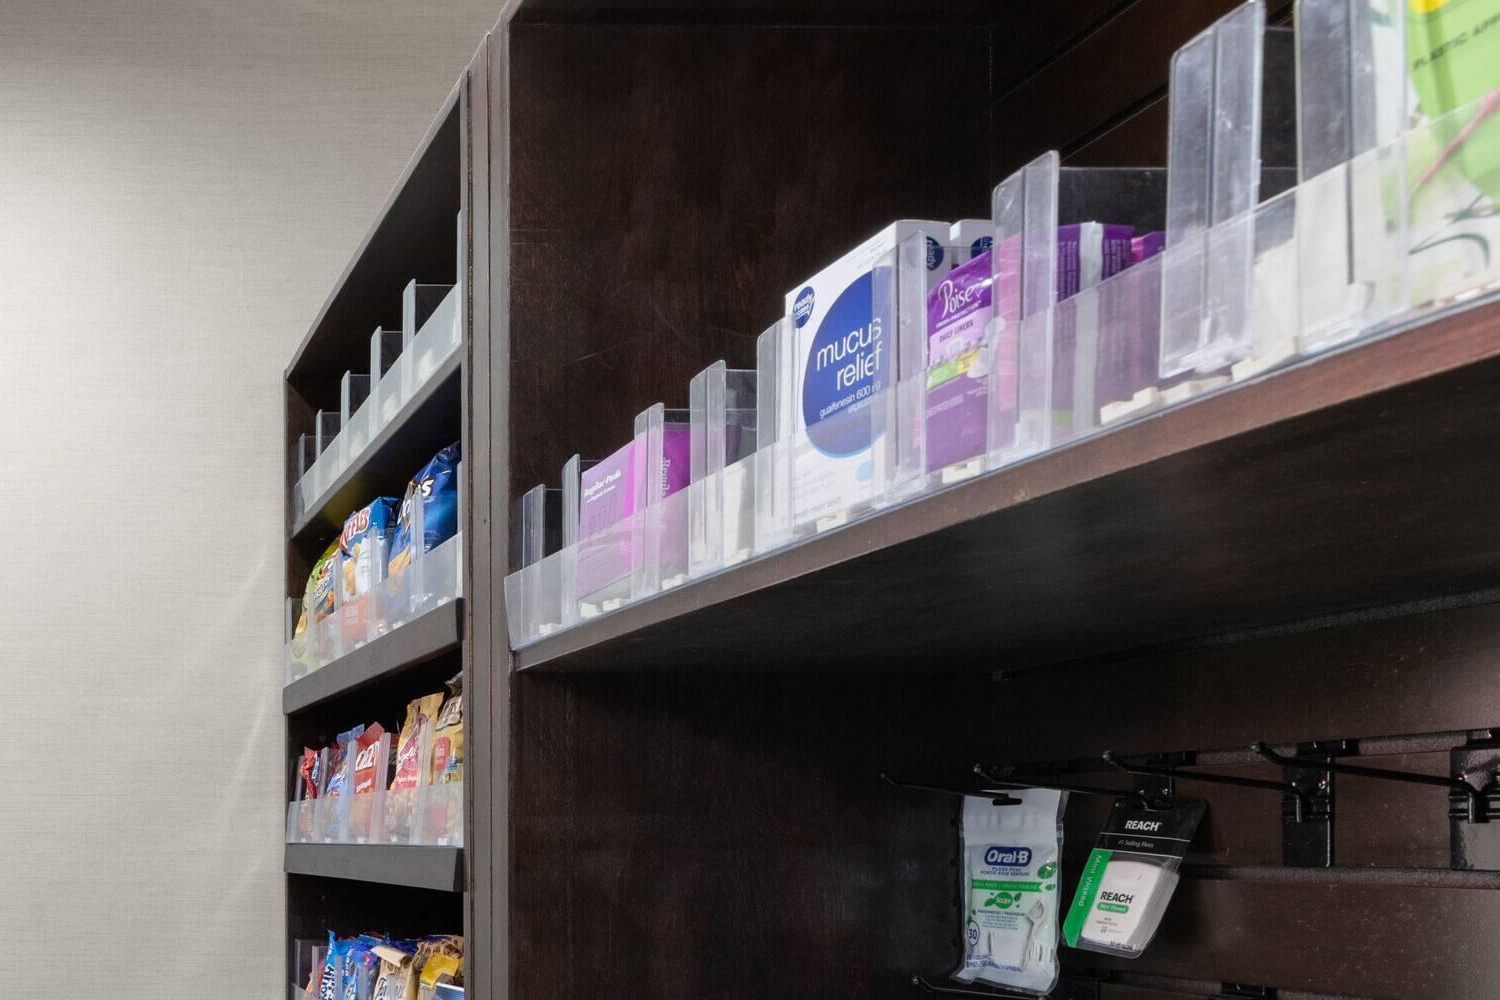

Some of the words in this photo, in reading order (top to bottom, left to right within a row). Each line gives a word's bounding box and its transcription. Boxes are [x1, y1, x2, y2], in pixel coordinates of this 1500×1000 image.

[938, 279, 975, 318] Poise
[955, 319, 974, 335] LINERS
[817, 317, 882, 372] mucus
[837, 341, 882, 392] relief
[856, 385, 870, 399] 600
[1125, 820, 1159, 831] REACH
[987, 849, 1029, 864] Oral-B
[1078, 876, 1093, 907] Waxed
[1100, 891, 1133, 904] REACH
[969, 929, 977, 940] 30
